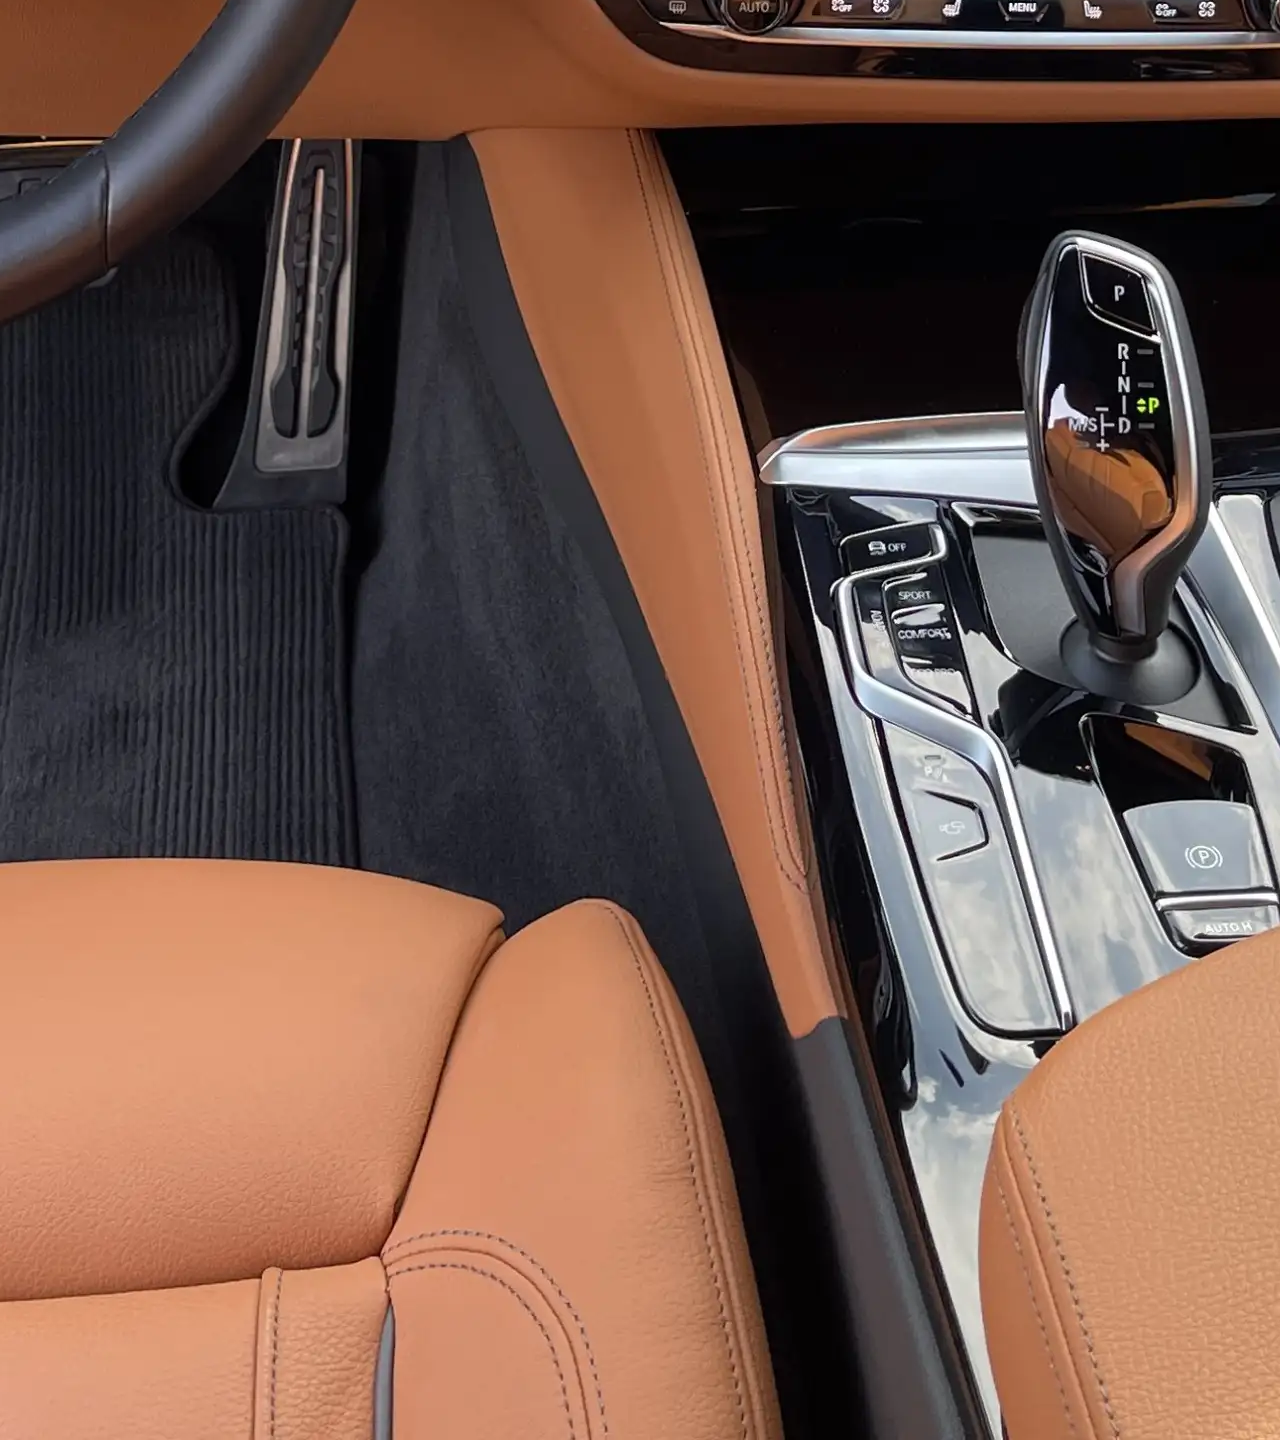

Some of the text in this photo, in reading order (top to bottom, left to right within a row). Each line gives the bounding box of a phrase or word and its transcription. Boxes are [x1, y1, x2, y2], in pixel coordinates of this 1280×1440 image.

[739, 2, 770, 13] AUTO
[1008, 2, 1037, 13] MENU
[1114, 285, 1126, 302] P
[1118, 343, 1130, 360] R
[1118, 376, 1131, 394] N
[1148, 397, 1160, 414] P
[1118, 418, 1132, 434] D
[888, 543, 907, 553] OFF
[898, 590, 932, 600] SPORT
[898, 628, 949, 640] COMFORT
[1205, 922, 1240, 934] AUTO
